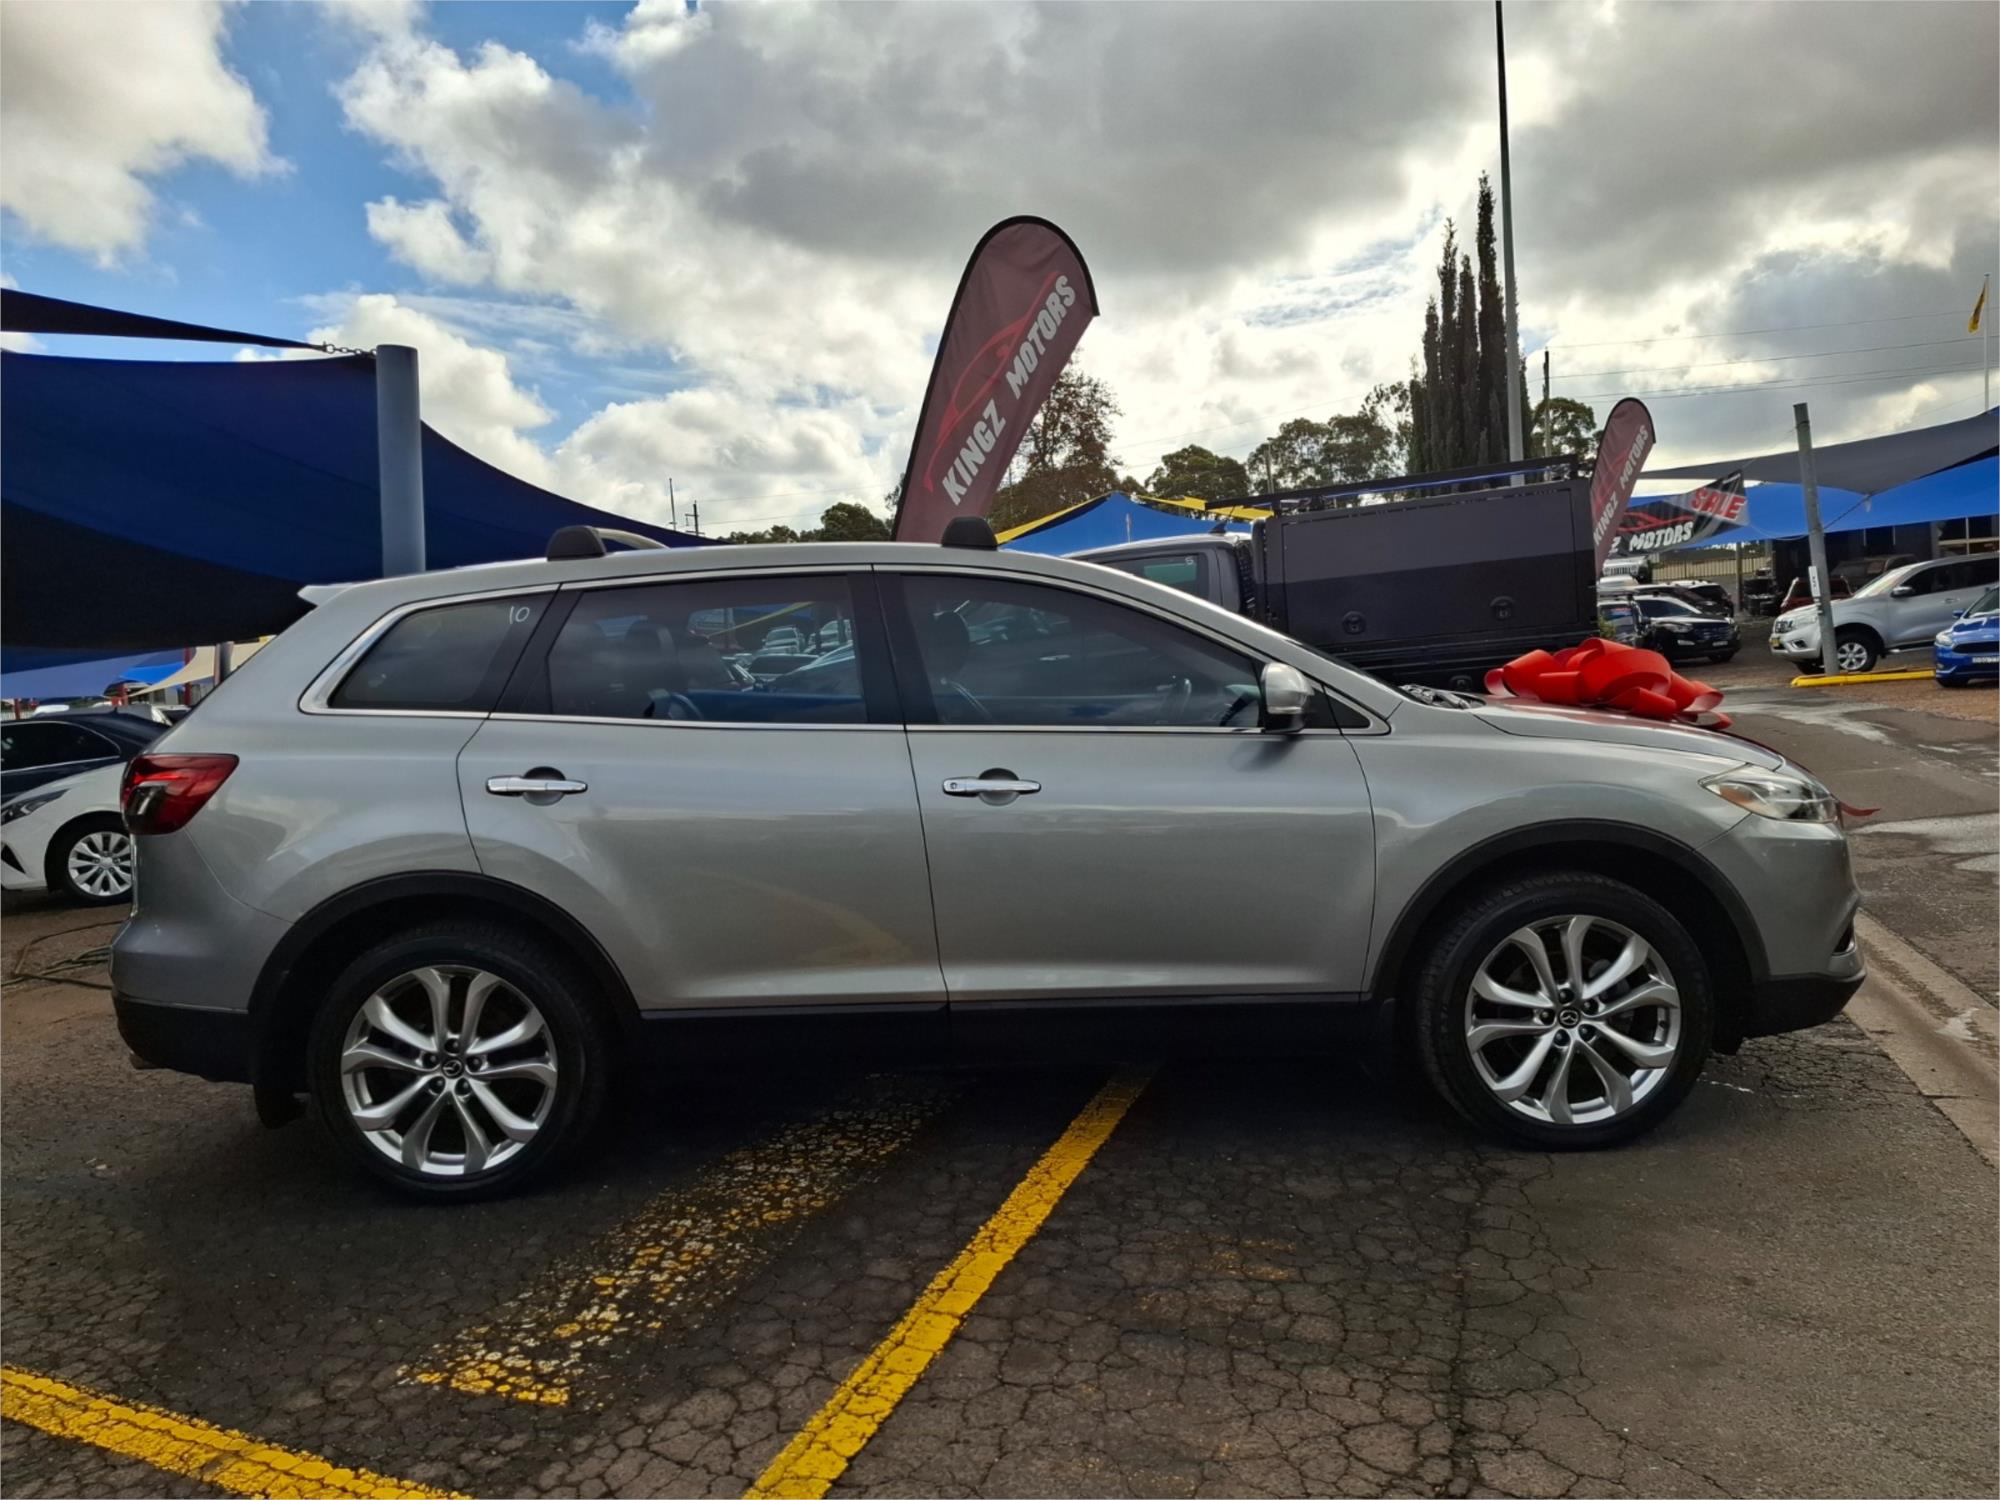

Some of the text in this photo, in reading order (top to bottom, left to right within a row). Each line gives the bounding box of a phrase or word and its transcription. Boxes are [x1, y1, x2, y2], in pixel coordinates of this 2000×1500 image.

[942, 274, 1077, 506] KINGZ MOTORS
[1593, 490, 1618, 546] KINGZ
[1619, 425, 1649, 489] MOTORS
[1690, 486, 1747, 520] SALE
[1629, 521, 1695, 552] MOTORS
[509, 605, 530, 625] 10
